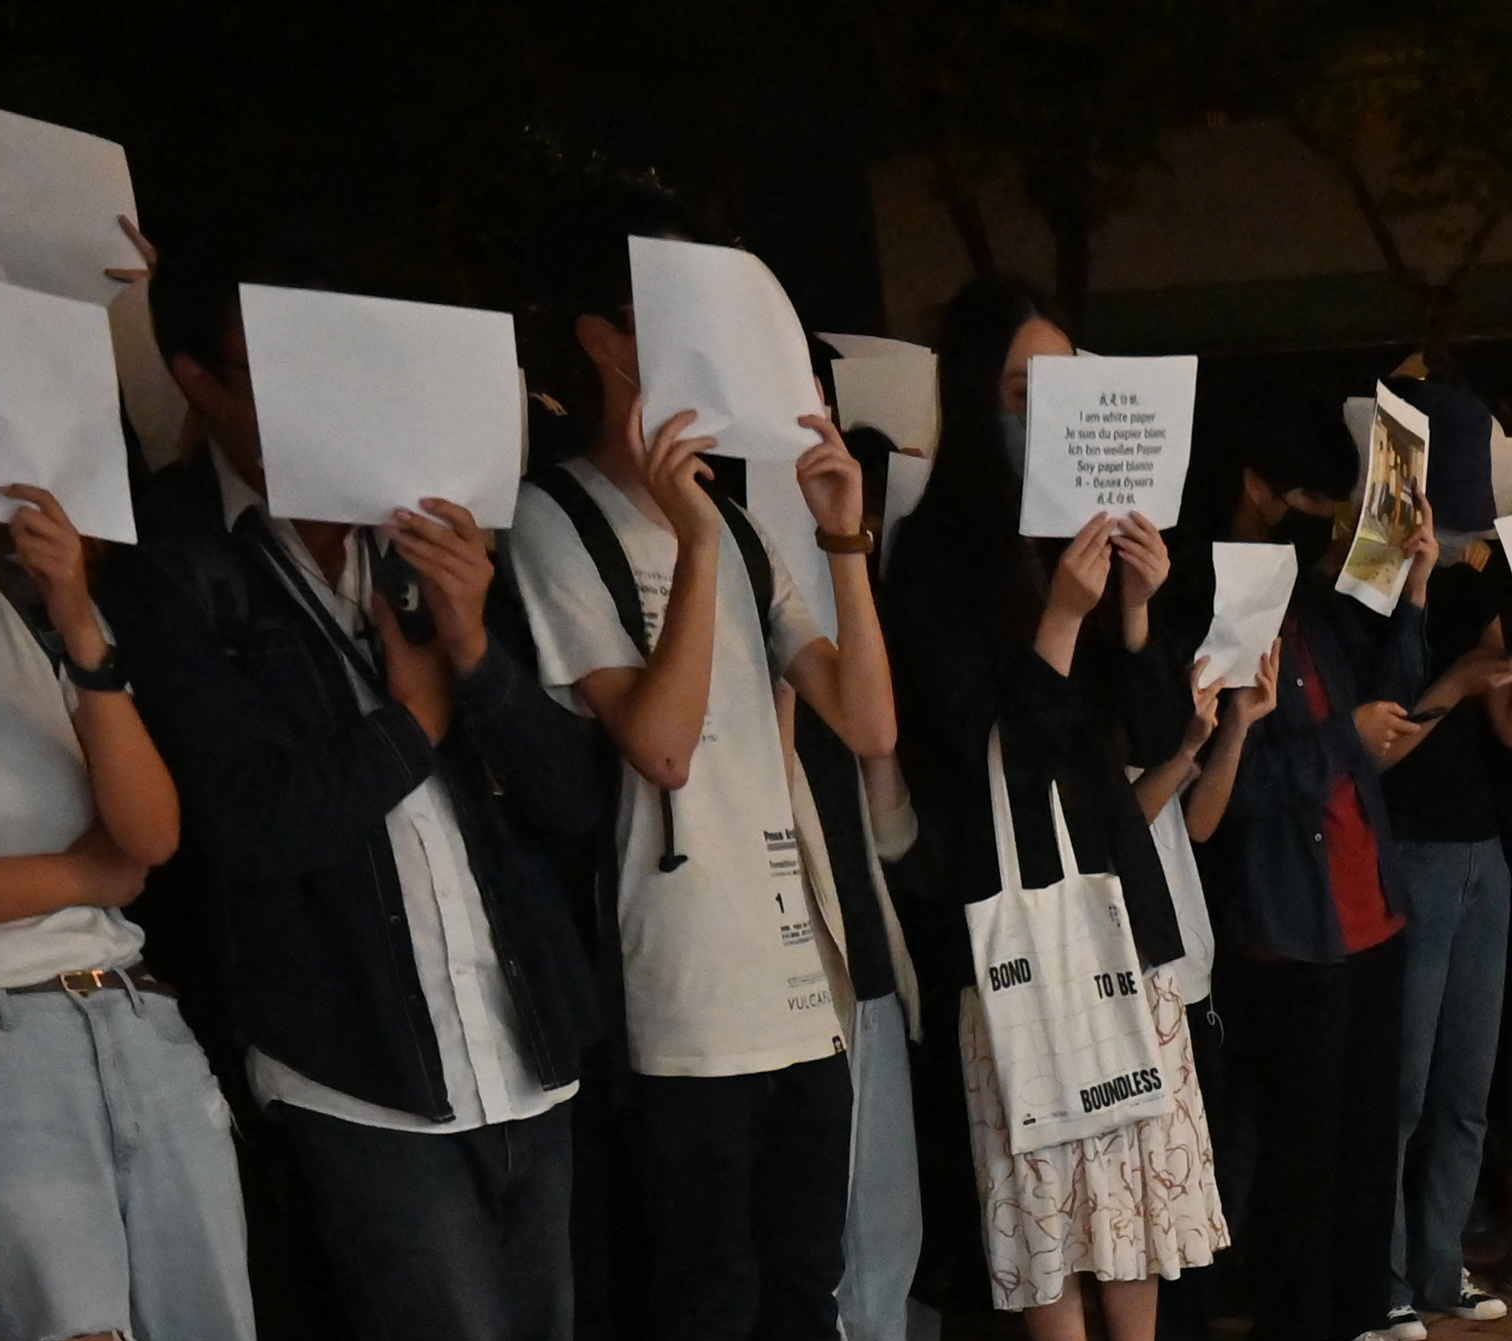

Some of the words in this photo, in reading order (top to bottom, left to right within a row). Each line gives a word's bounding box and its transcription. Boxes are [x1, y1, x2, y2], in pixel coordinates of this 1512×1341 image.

[1085, 413, 1100, 422] am
[1102, 412, 1128, 423] white
[1130, 413, 1156, 425] paper
[1099, 428, 1111, 439] du
[1068, 443, 1083, 456] Ich
[1077, 459, 1095, 475] Soy
[1097, 460, 1124, 474] papel
[775, 892, 785, 914] 1
[988, 957, 1033, 993] BOND
[1094, 973, 1116, 999] TO
[1116, 971, 1138, 996] BE
[1079, 1067, 1163, 1114] BOUNDLESS
